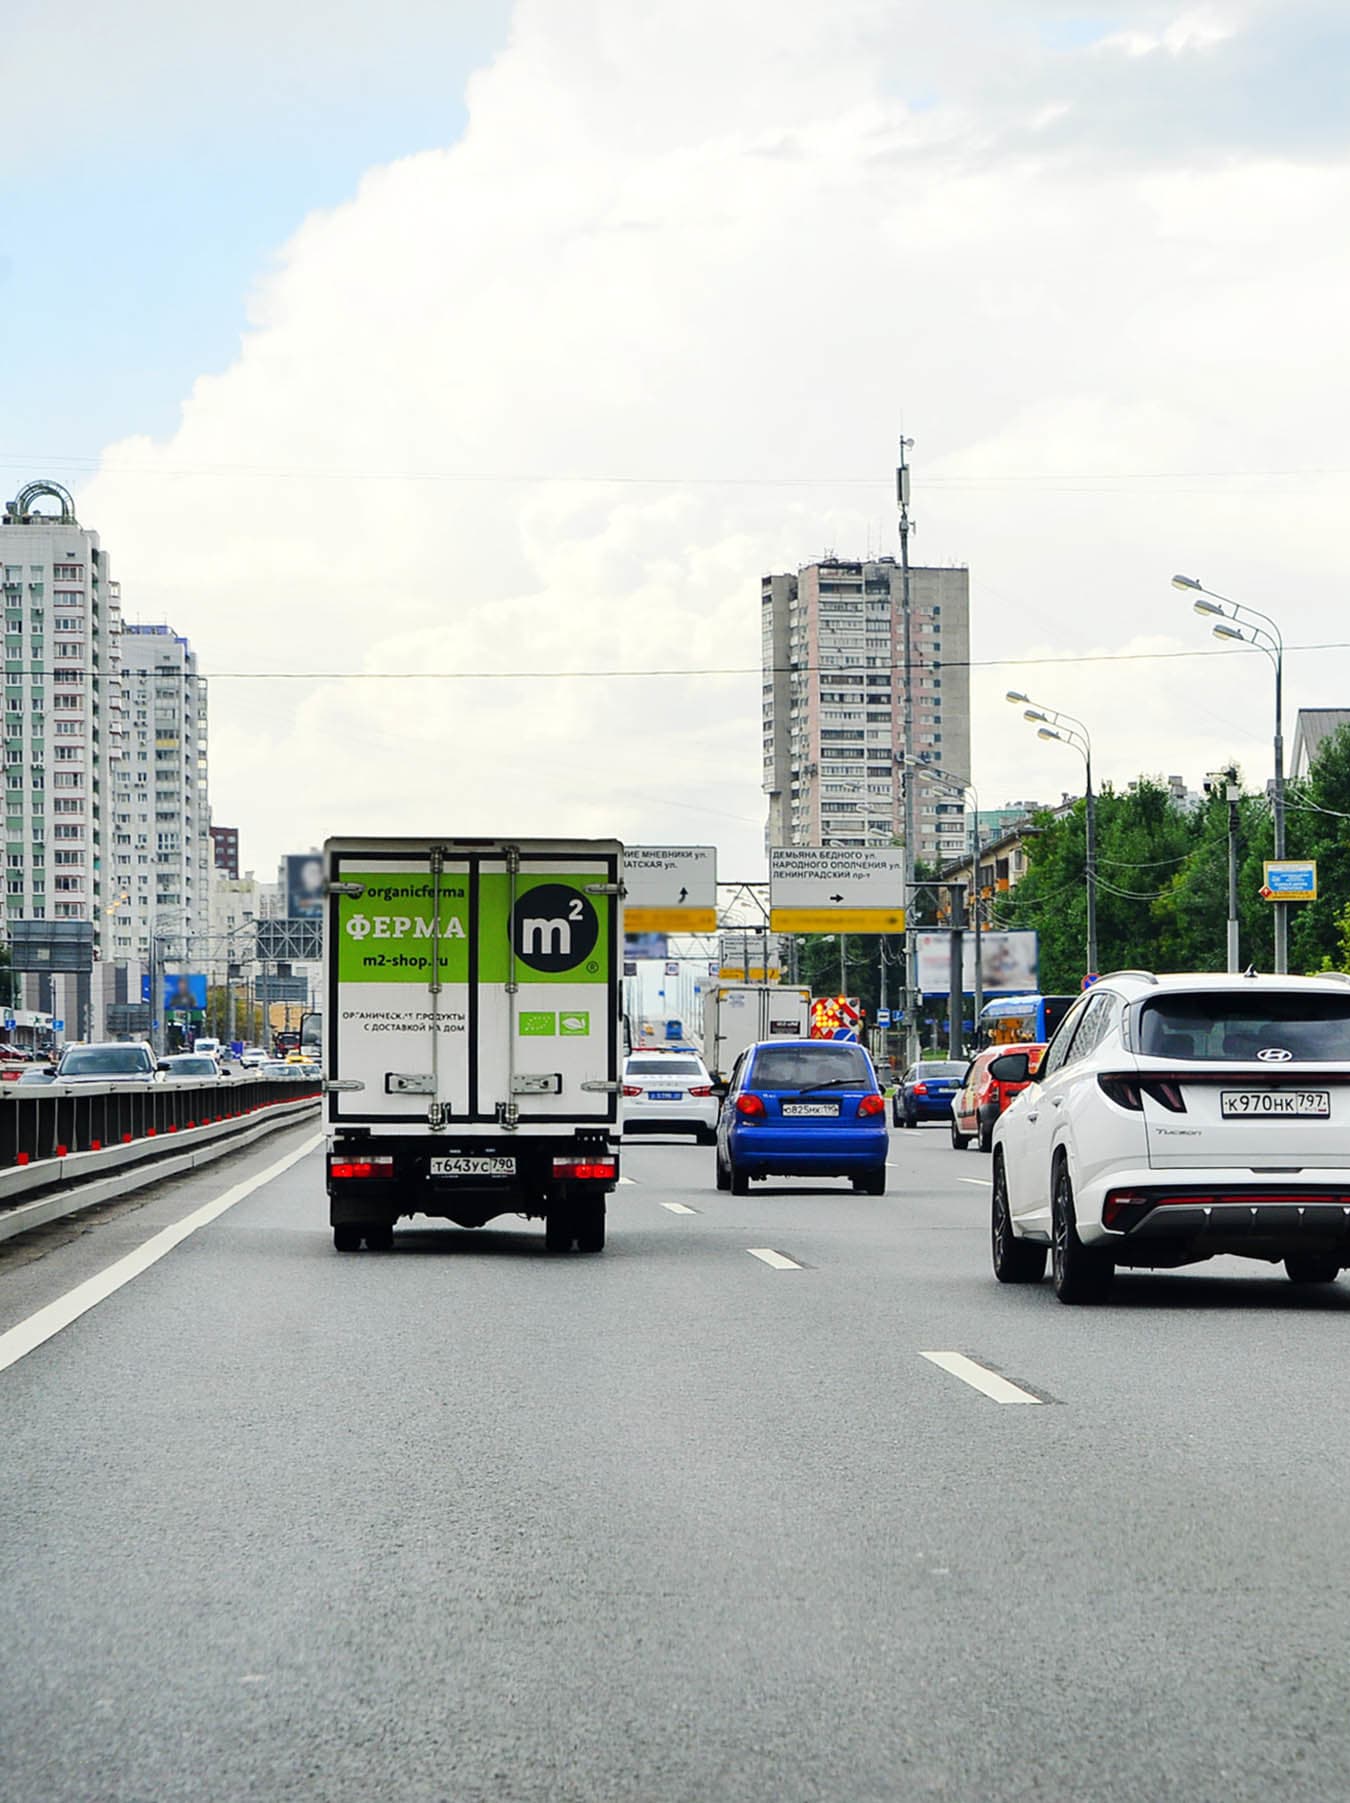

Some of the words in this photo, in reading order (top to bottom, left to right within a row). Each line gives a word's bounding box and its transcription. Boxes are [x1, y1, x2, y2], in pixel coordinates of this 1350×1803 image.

[642, 850, 693, 859] МНЕВНИКИ
[773, 851, 817, 860] ДЕМЬЯНА
[819, 851, 863, 860] БЕДНОГО
[773, 861, 829, 869] НАРОДНОГО
[830, 861, 887, 869] ОПОЛЧЕНИЯ
[773, 870, 851, 879] ЛЕНИНГРАДСКИЙ
[367, 885, 465, 901] organicferma
[346, 914, 466, 940] ФЕРМА
[371, 1022, 426, 1032] ДОСТАВКОЙ
[443, 1024, 465, 1033] ДОМ
